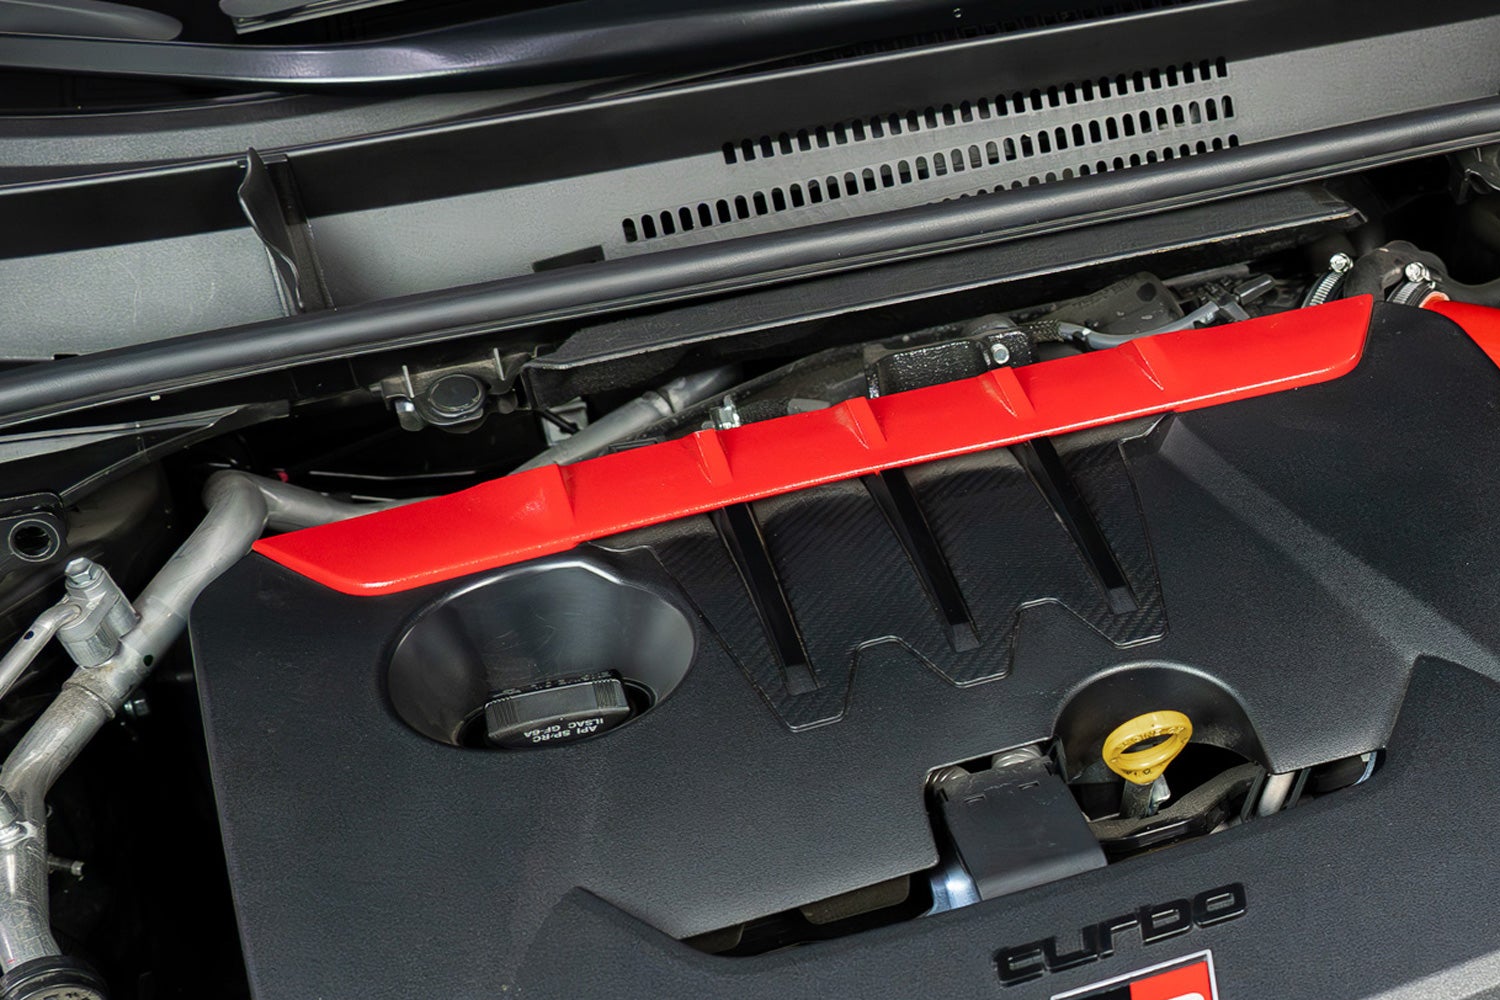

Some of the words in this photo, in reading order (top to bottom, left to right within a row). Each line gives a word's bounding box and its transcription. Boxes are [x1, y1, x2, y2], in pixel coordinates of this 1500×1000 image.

[568, 717, 604, 729] ILSAC
[523, 724, 562, 738] GF-6A
[577, 725, 598, 737] API
[993, 882, 1247, 988] turbo
